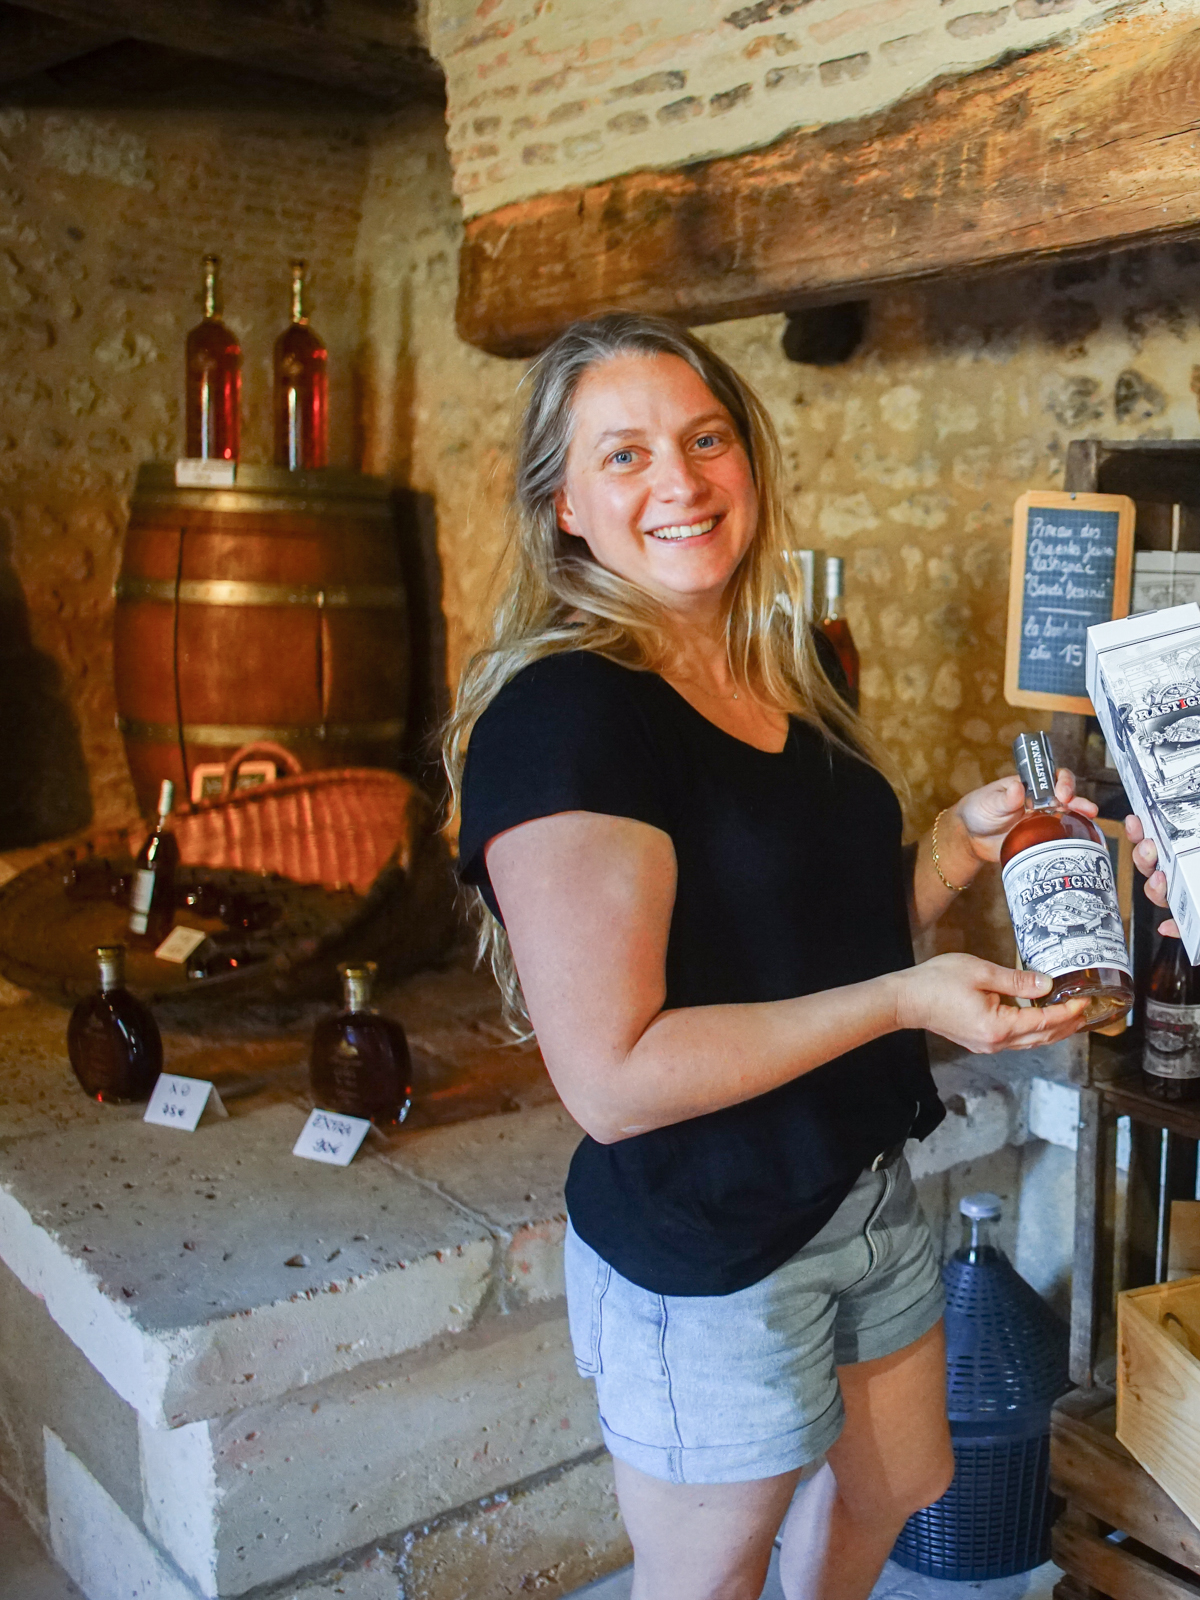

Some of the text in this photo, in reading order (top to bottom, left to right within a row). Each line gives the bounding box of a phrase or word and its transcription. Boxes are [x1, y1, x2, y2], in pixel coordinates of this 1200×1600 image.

[1030, 740, 1049, 790] RASTIGNAC
[1021, 875, 1111, 905] RASTIGNAC
[1064, 904, 1082, 916] DES
